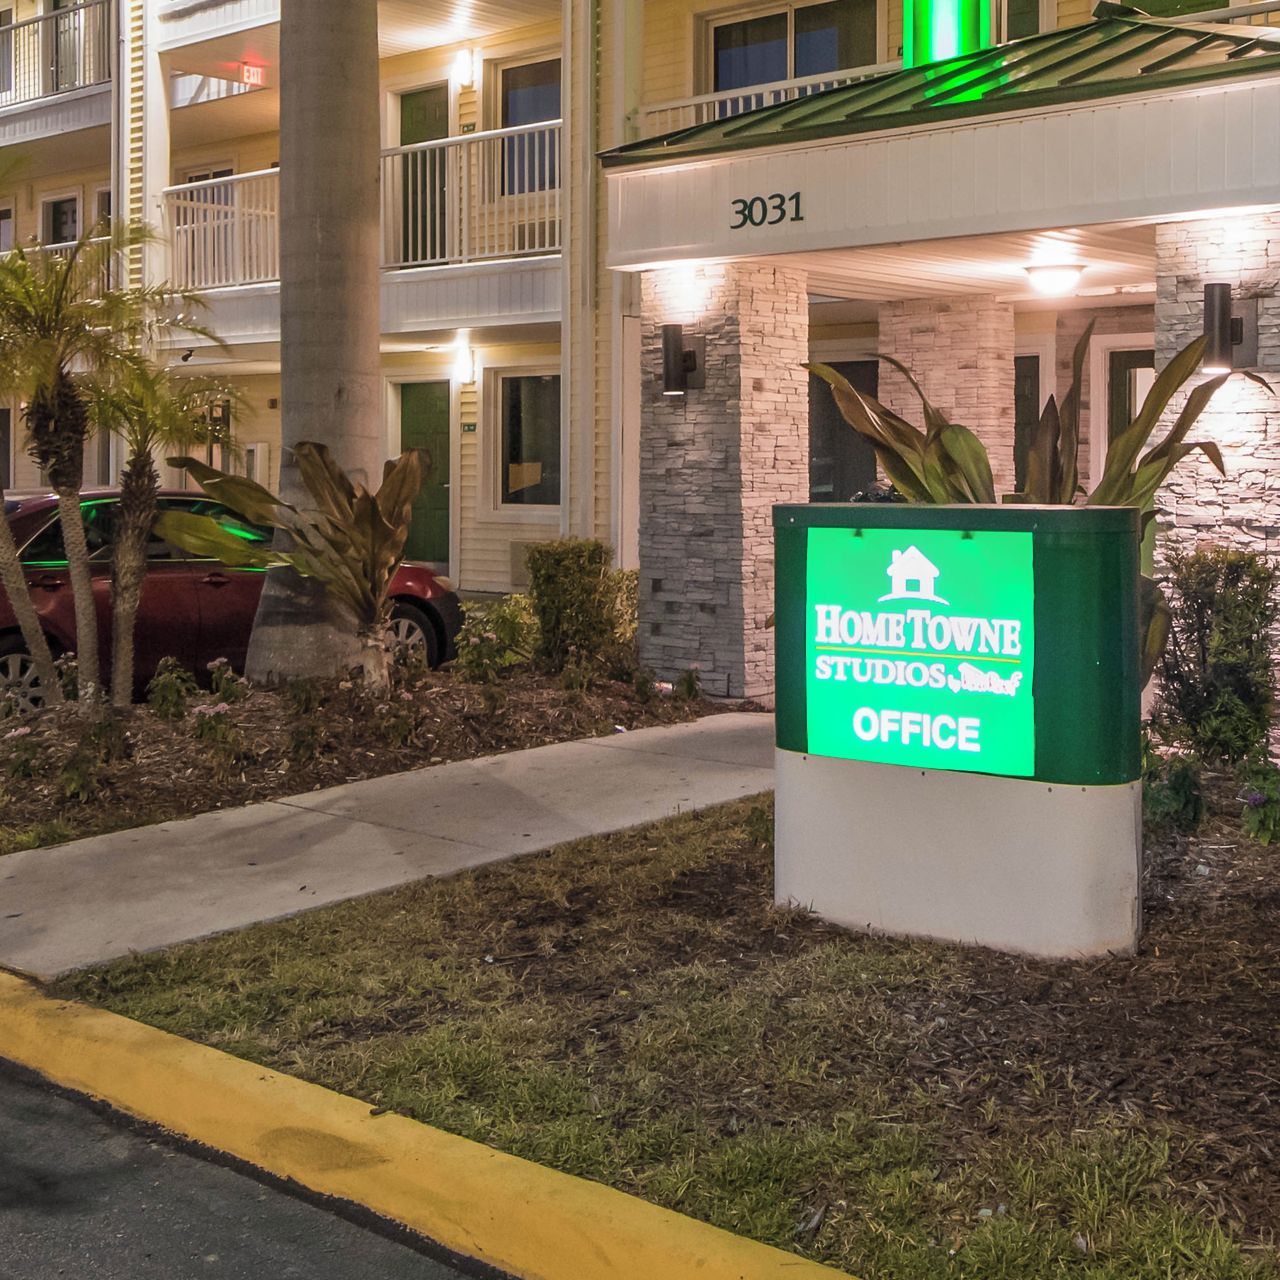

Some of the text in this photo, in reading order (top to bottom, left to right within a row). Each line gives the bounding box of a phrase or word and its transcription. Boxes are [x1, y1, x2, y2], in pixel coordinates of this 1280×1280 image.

[243, 65, 263, 85] EXIT
[730, 191, 804, 230] 3031
[815, 655, 946, 688] STUDIOS
[853, 707, 981, 752] OFFICE
